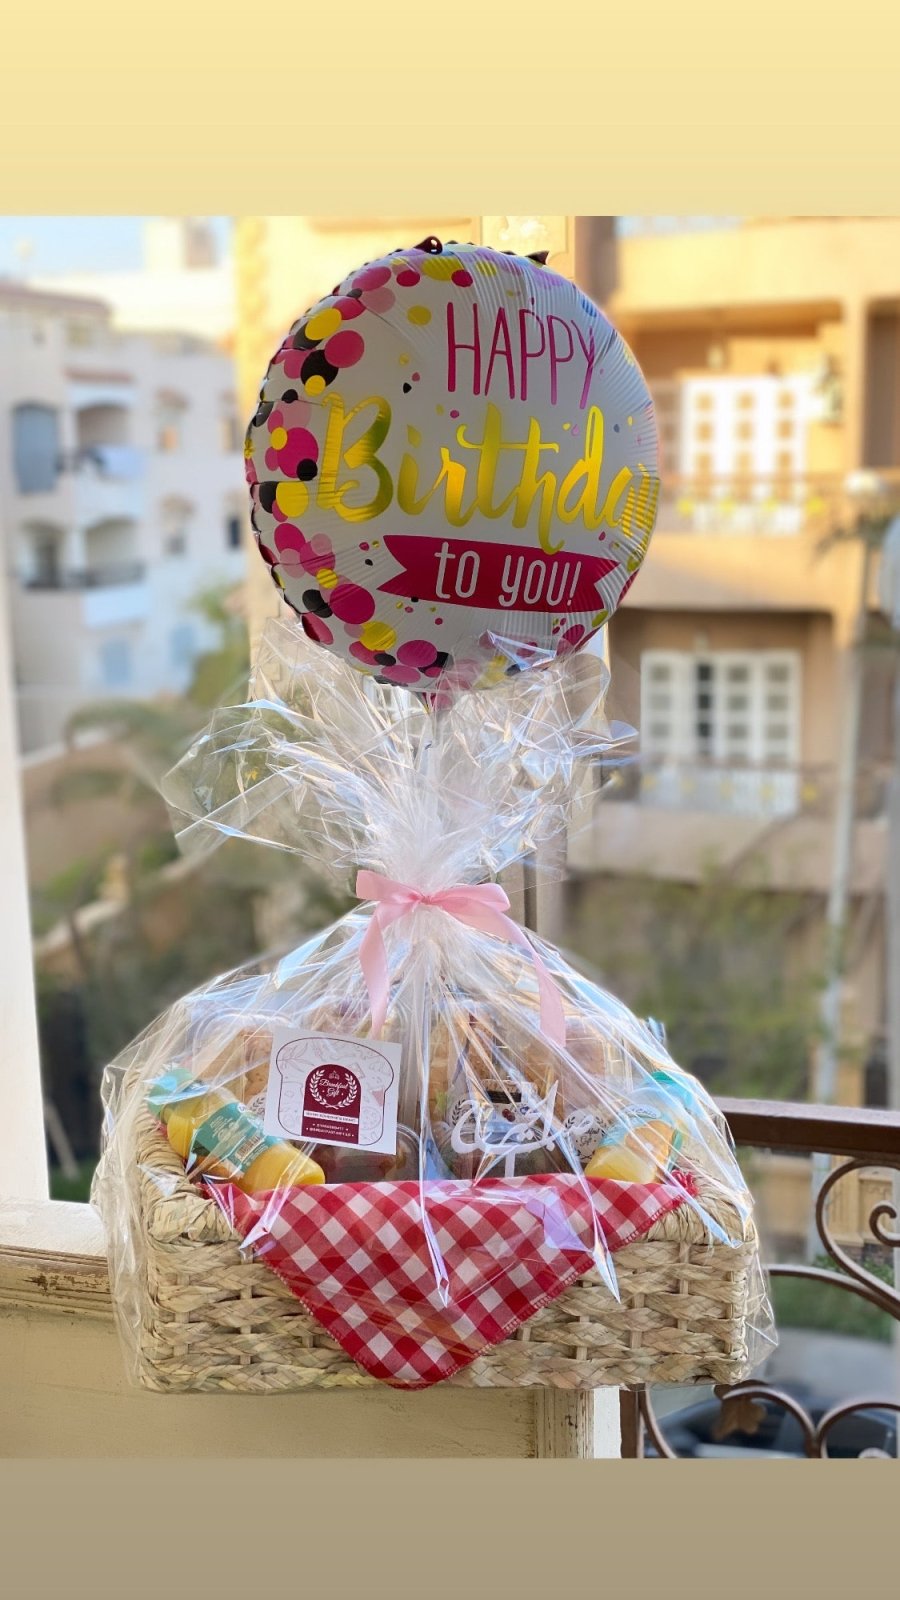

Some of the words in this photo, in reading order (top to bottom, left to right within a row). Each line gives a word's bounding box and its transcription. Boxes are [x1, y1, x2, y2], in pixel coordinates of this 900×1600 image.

[446, 301, 594, 410] HAPPY
[434, 541, 480, 600] to
[498, 554, 582, 606] you!
